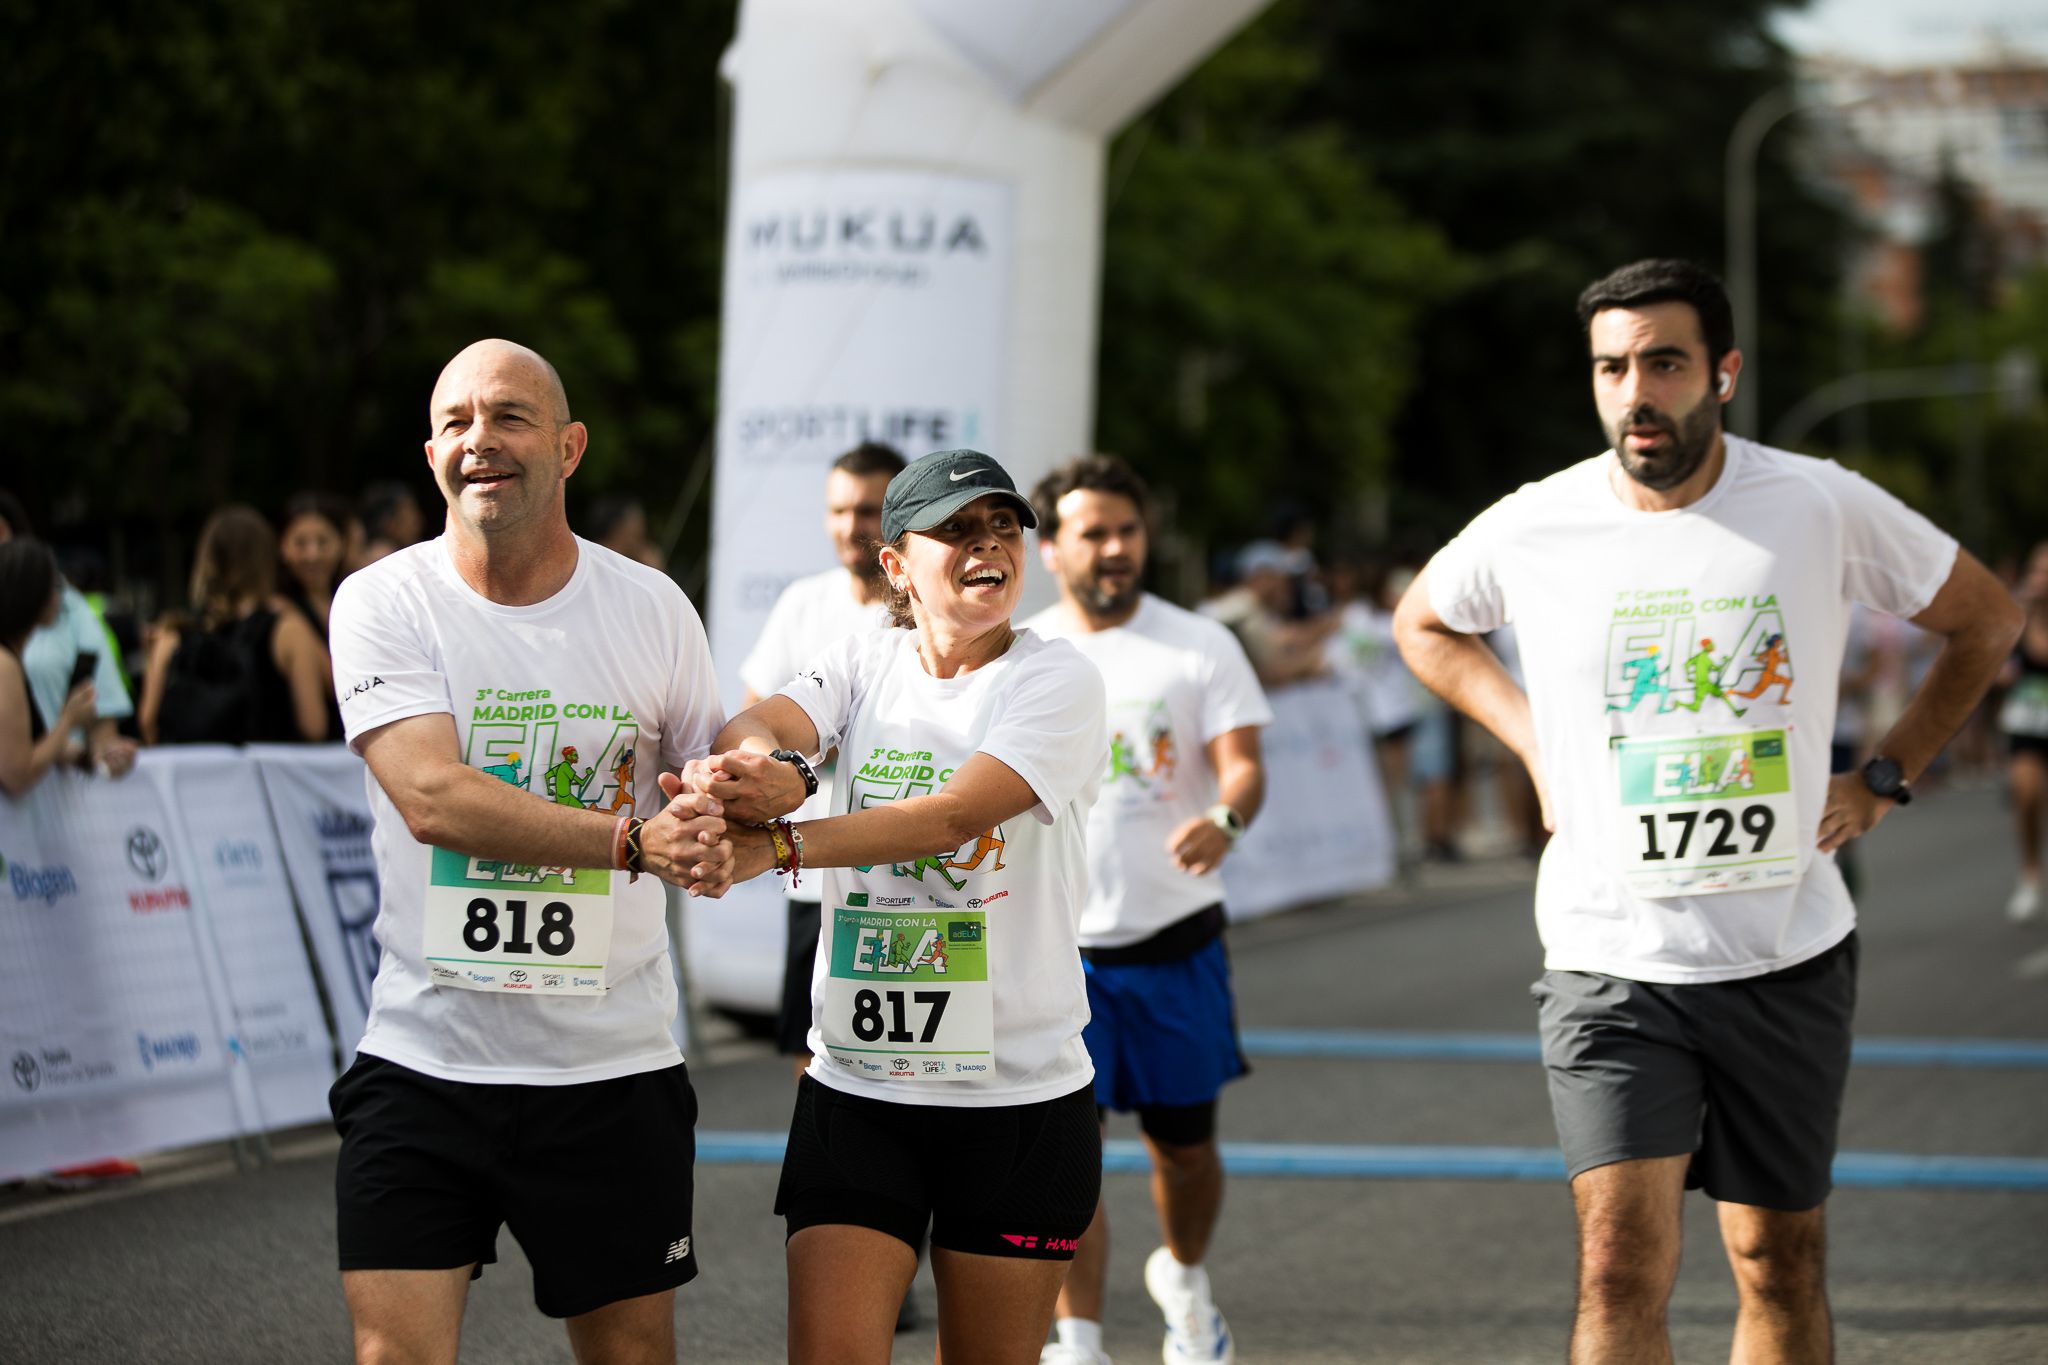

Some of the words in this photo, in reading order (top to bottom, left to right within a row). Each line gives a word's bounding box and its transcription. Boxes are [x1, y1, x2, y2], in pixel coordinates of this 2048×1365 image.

[1613, 601, 1695, 618] MADRID
[1701, 596, 1746, 612] CON
[1752, 594, 1777, 609] LA
[1604, 609, 1794, 698] ELA
[496, 689, 552, 702] Carrera
[473, 703, 558, 721] MADRID
[563, 703, 607, 720] CON
[612, 705, 637, 721] LA
[887, 749, 933, 762] Carrera
[858, 763, 935, 781] MADRID
[1653, 748, 1754, 797] ELA
[1639, 804, 1776, 861] 1729
[876, 895, 912, 904] SPORTLIFE
[463, 897, 575, 957] 818
[860, 916, 893, 927] MADRID
[895, 918, 920, 927] CON
[922, 918, 937, 927] LA
[853, 927, 948, 974] ELA
[473, 974, 495, 983] Biogen
[852, 988, 951, 1043] 817
